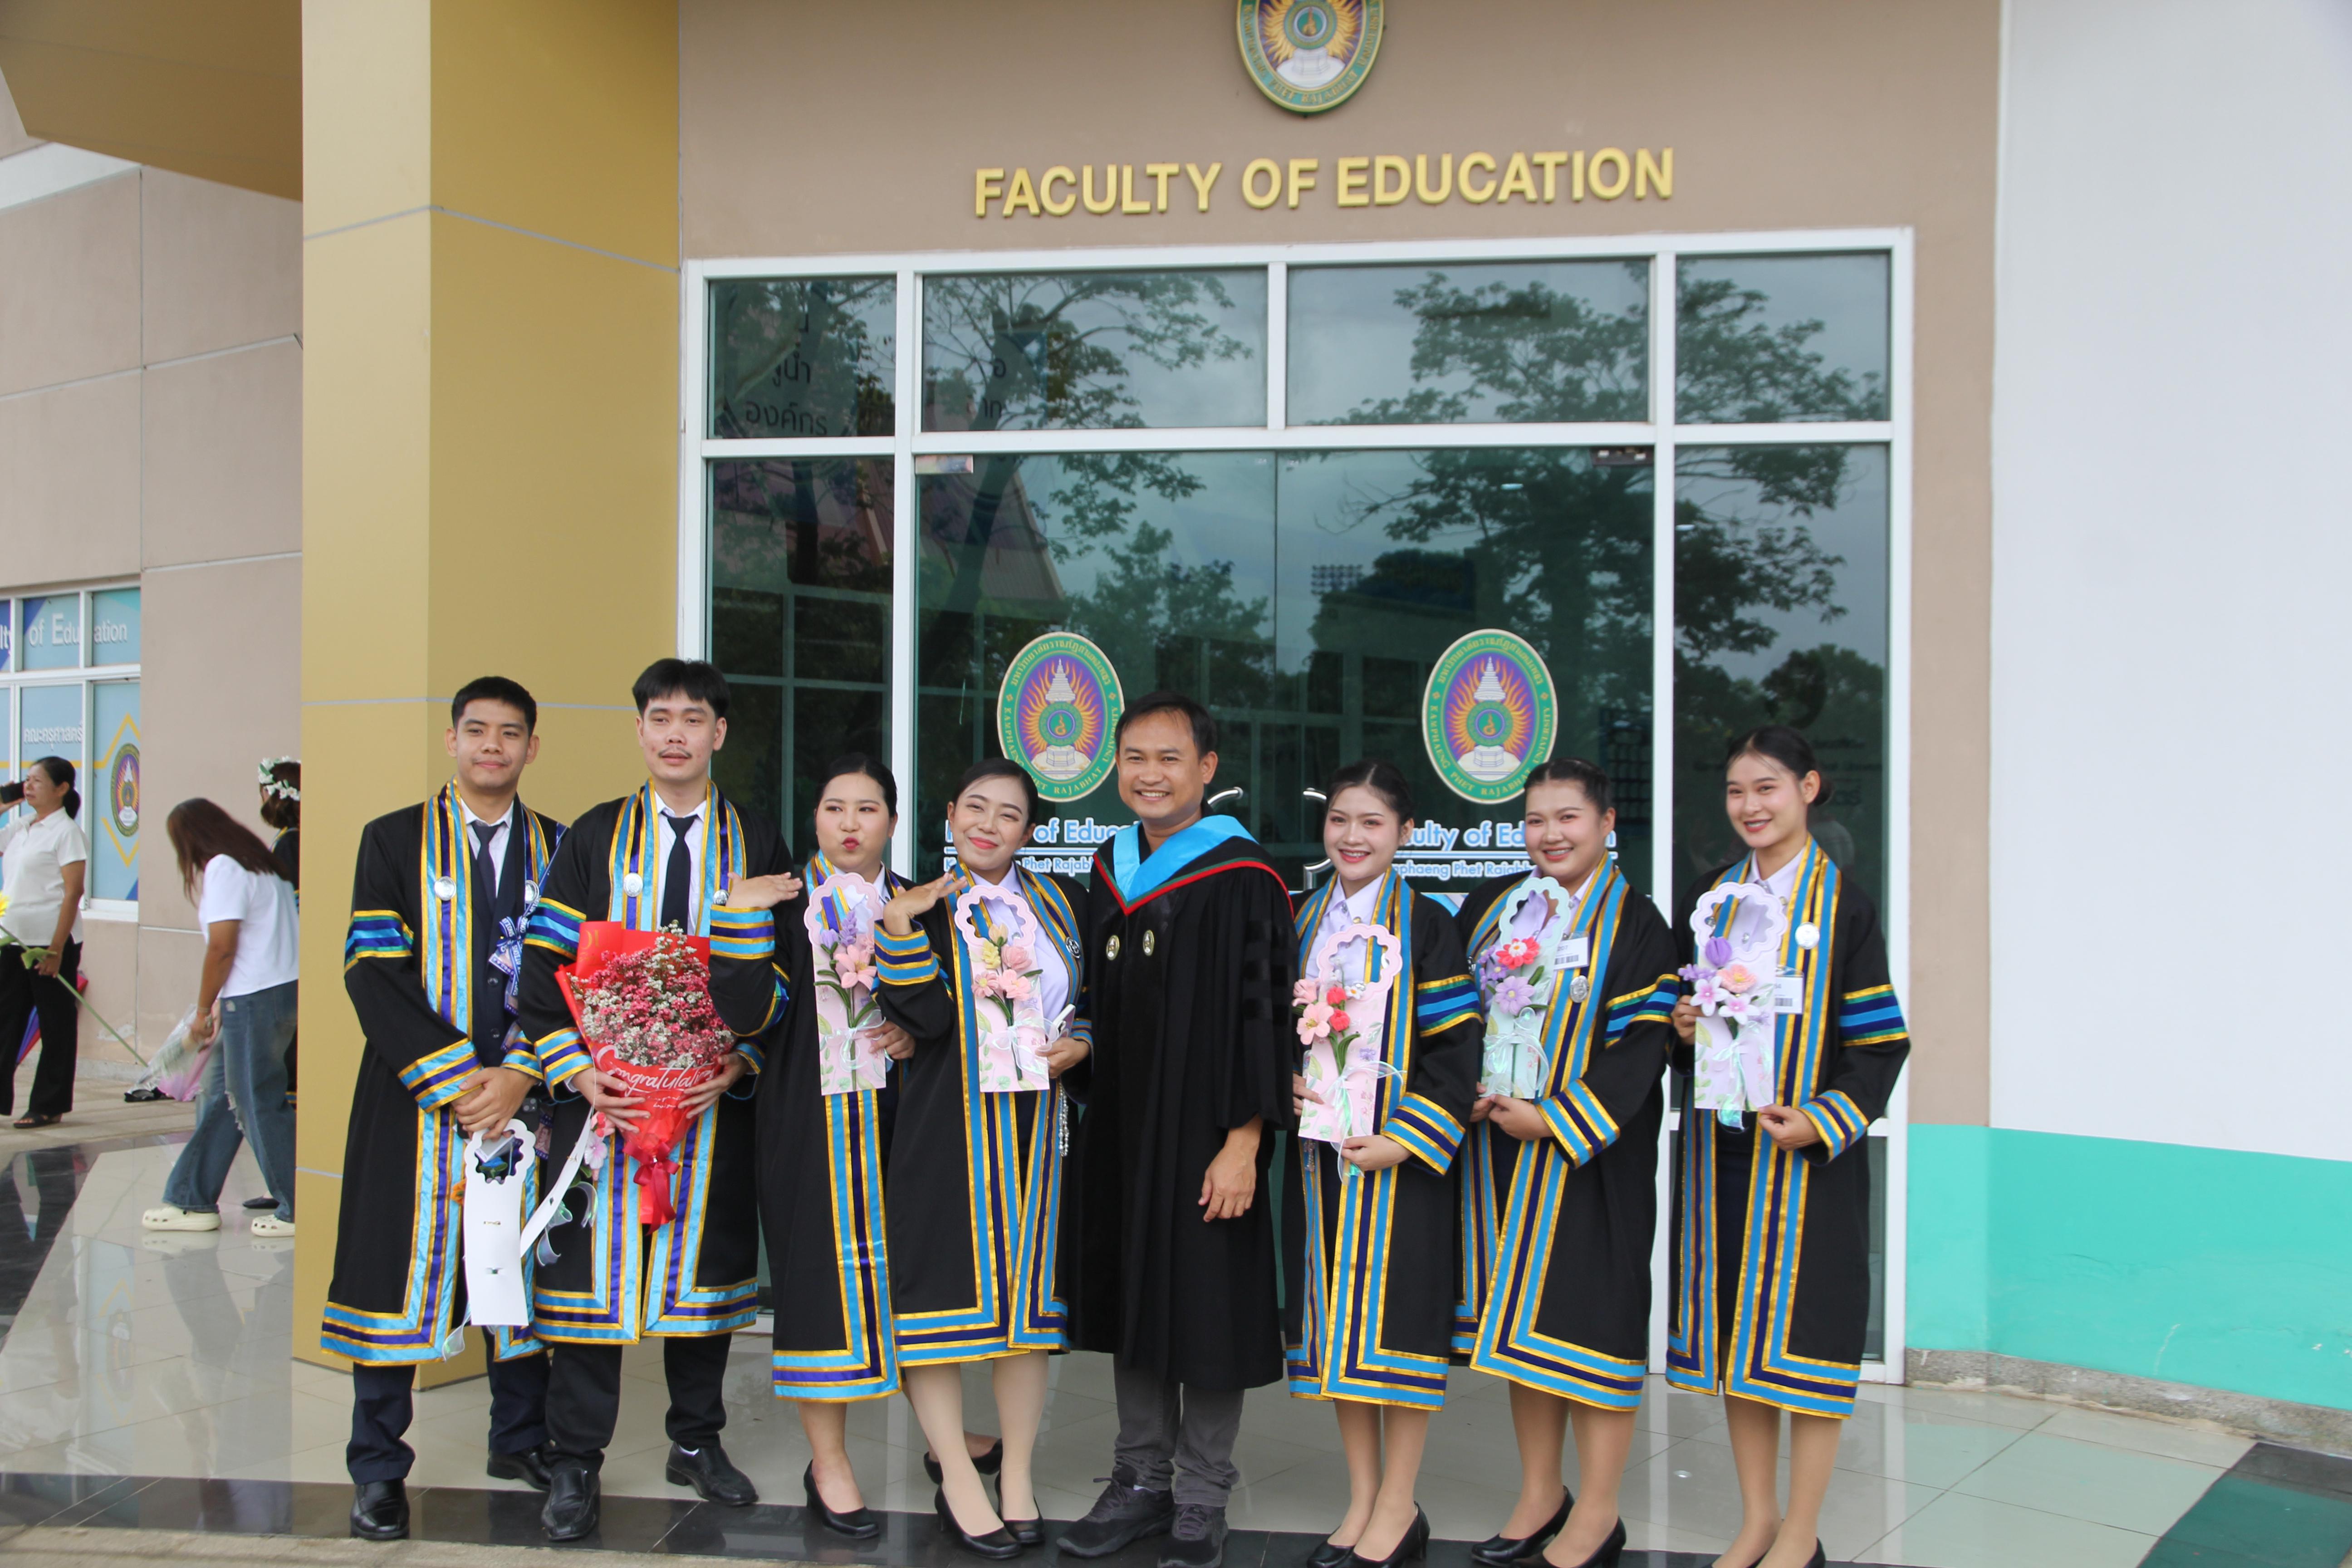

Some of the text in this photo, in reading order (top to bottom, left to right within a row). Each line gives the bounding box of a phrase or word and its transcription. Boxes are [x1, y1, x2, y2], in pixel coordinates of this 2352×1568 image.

[975, 147, 1673, 217] FACULTY OF EDUCATION
[29, 619, 44, 647] of
[52, 612, 127, 647] Eduation
[1431, 705, 1451, 769] KAMPHAENG
[1450, 772, 1475, 791] PHET
[1532, 707, 1551, 764] UNIVERSITY
[1054, 766, 1102, 795] RAJABHAT
[1034, 818, 1059, 842] of
[1407, 820, 1459, 850] ulty
[1464, 821, 1492, 845] of
[1023, 857, 1093, 876] Phet Rajab
[1393, 860, 1534, 880] phaeng Phet Rajabh
